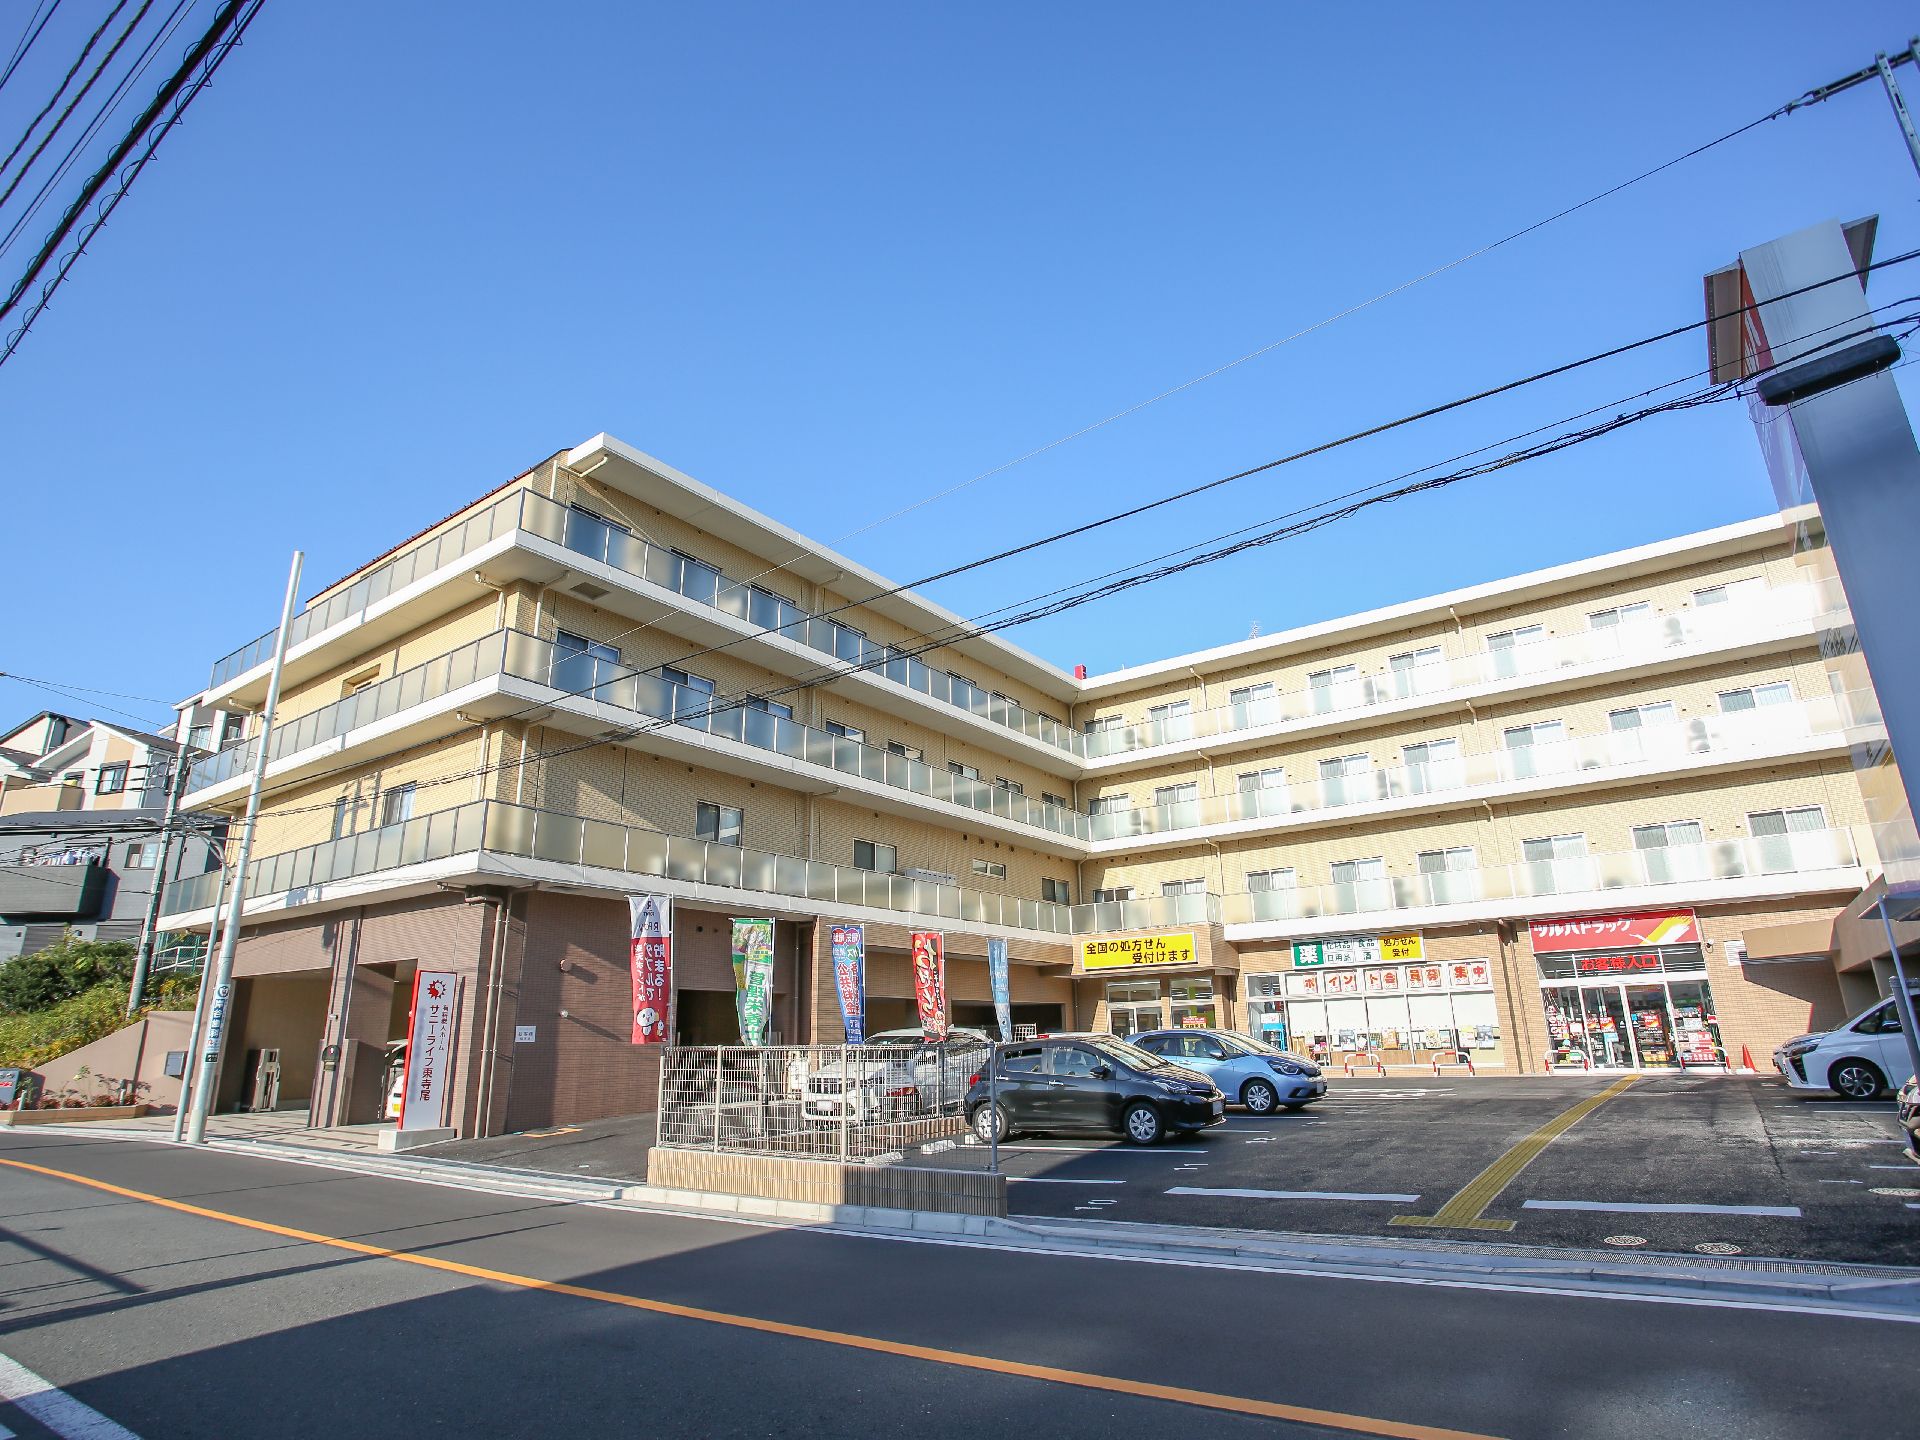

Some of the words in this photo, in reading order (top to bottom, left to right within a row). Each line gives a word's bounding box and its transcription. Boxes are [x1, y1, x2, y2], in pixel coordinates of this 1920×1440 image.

[1533, 918, 1636, 938] ツルハドラッグ
[1086, 938, 1166, 955] 全国の処方せん
[1358, 938, 1375, 948] 食品
[1383, 937, 1416, 947] 処方せん
[1132, 949, 1190, 965] 受付けます
[1299, 944, 1318, 964] 薬
[1363, 951, 1372, 961] 酒
[1392, 948, 1409, 958] 受付
[1581, 954, 1657, 971] お客様入口
[419, 1004, 440, 1101] サニーライフ東寺尾
